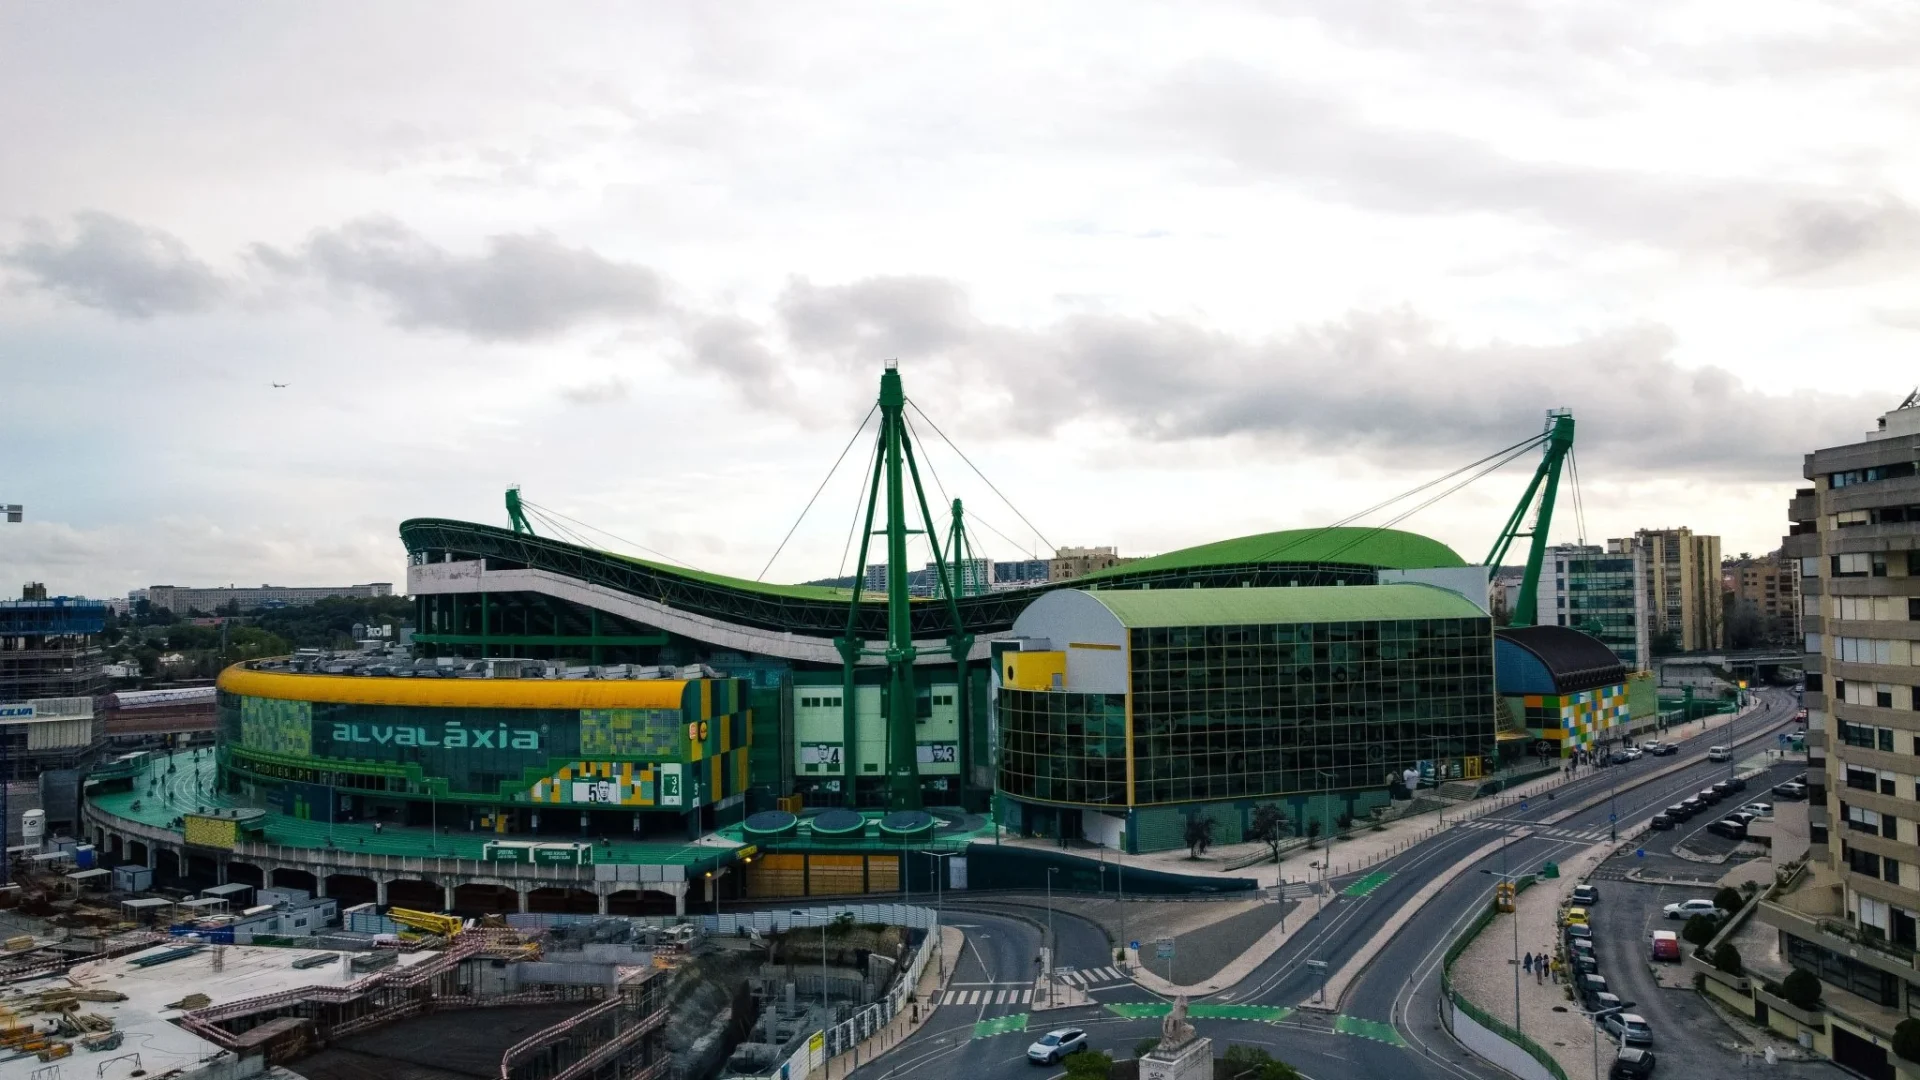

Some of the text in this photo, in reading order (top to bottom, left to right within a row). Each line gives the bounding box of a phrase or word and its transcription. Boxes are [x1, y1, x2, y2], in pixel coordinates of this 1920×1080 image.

[831, 748, 839, 763] 4
[946, 747, 954, 762] 3
[671, 776, 677, 785] 3
[588, 784, 597, 802] 5
